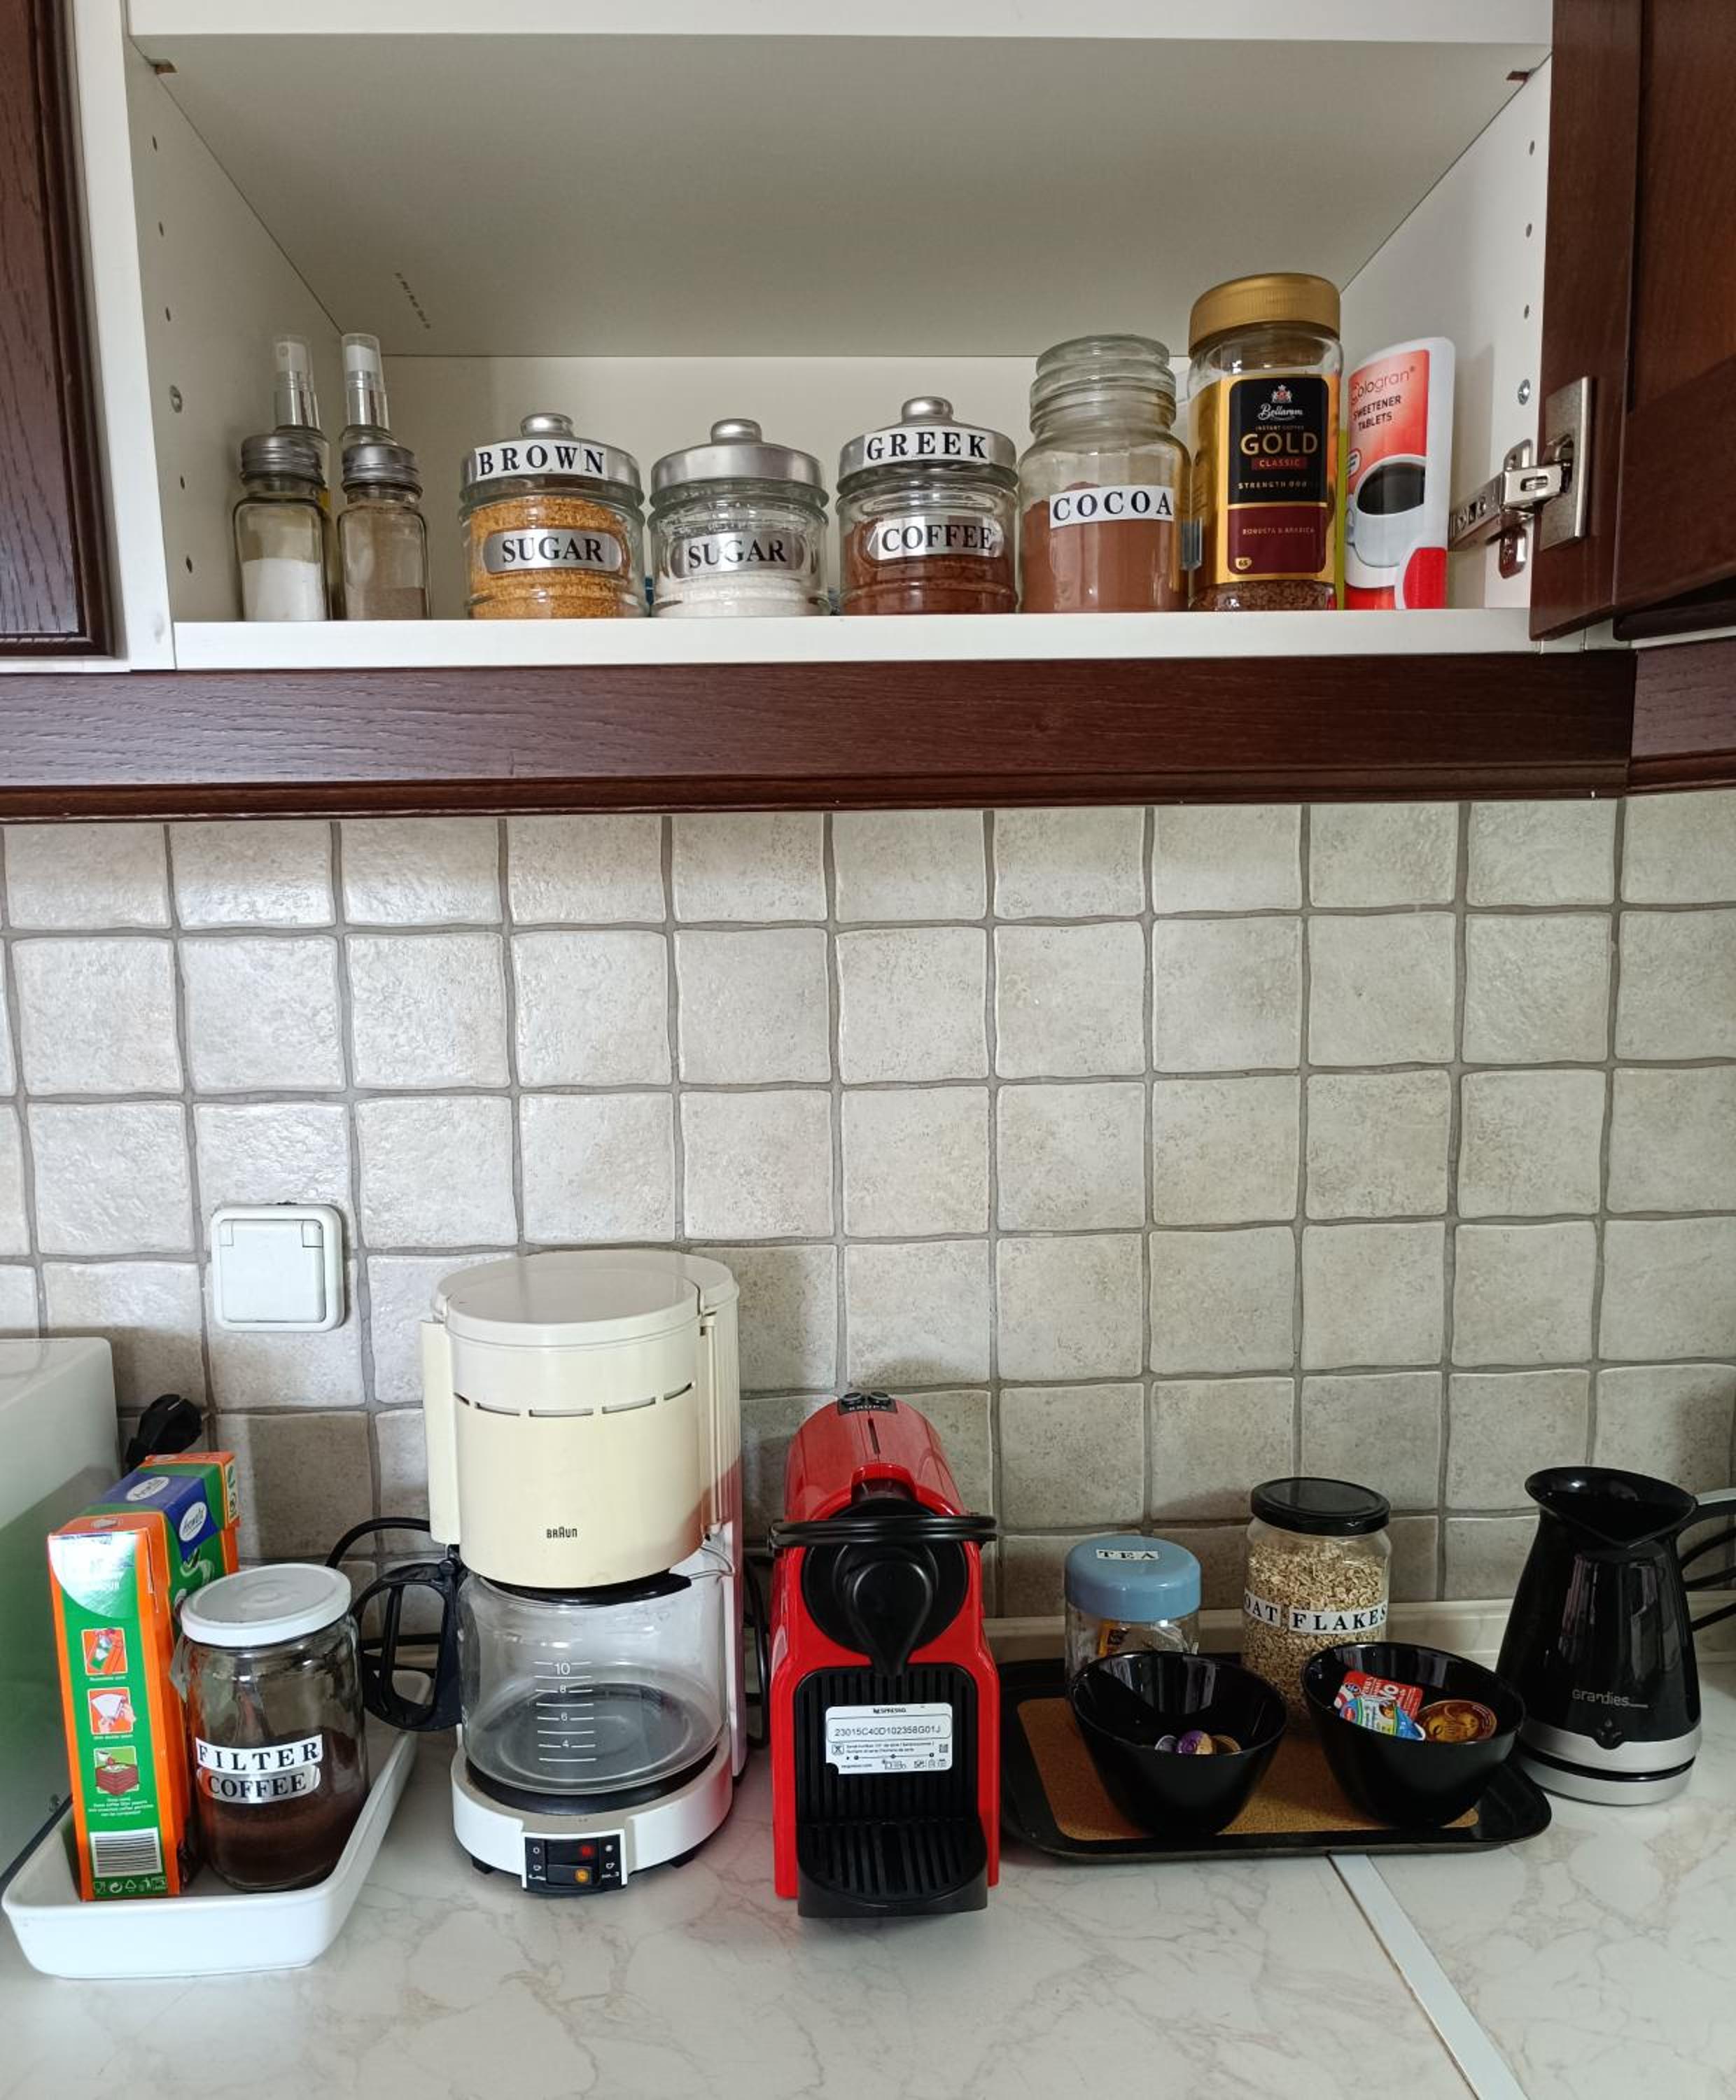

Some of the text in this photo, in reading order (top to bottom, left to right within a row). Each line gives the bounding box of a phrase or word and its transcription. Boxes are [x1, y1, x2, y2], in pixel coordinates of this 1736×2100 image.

[1352, 394, 1401, 421] SWEETENER
[1357, 412, 1393, 432] TABLETS
[866, 431, 988, 461] GREEK
[1240, 431, 1318, 456] GOLD
[478, 444, 604, 477] BROWN
[1259, 459, 1301, 468] CLASSIC
[1052, 490, 1172, 522] COCOA
[501, 536, 605, 563] SUGAR
[881, 525, 995, 552] COFFEE
[687, 538, 788, 569] SUGAR
[546, 1525, 578, 1539] BRAUN
[1098, 1550, 1154, 1559] TEA
[1292, 1604, 1386, 1631] FLAKES
[554, 1662, 571, 1675] 10
[560, 1684, 566, 1693] 8
[198, 1742, 318, 1770] FILTER
[562, 1739, 569, 1748] 4
[208, 1772, 307, 1798] COFFEE
